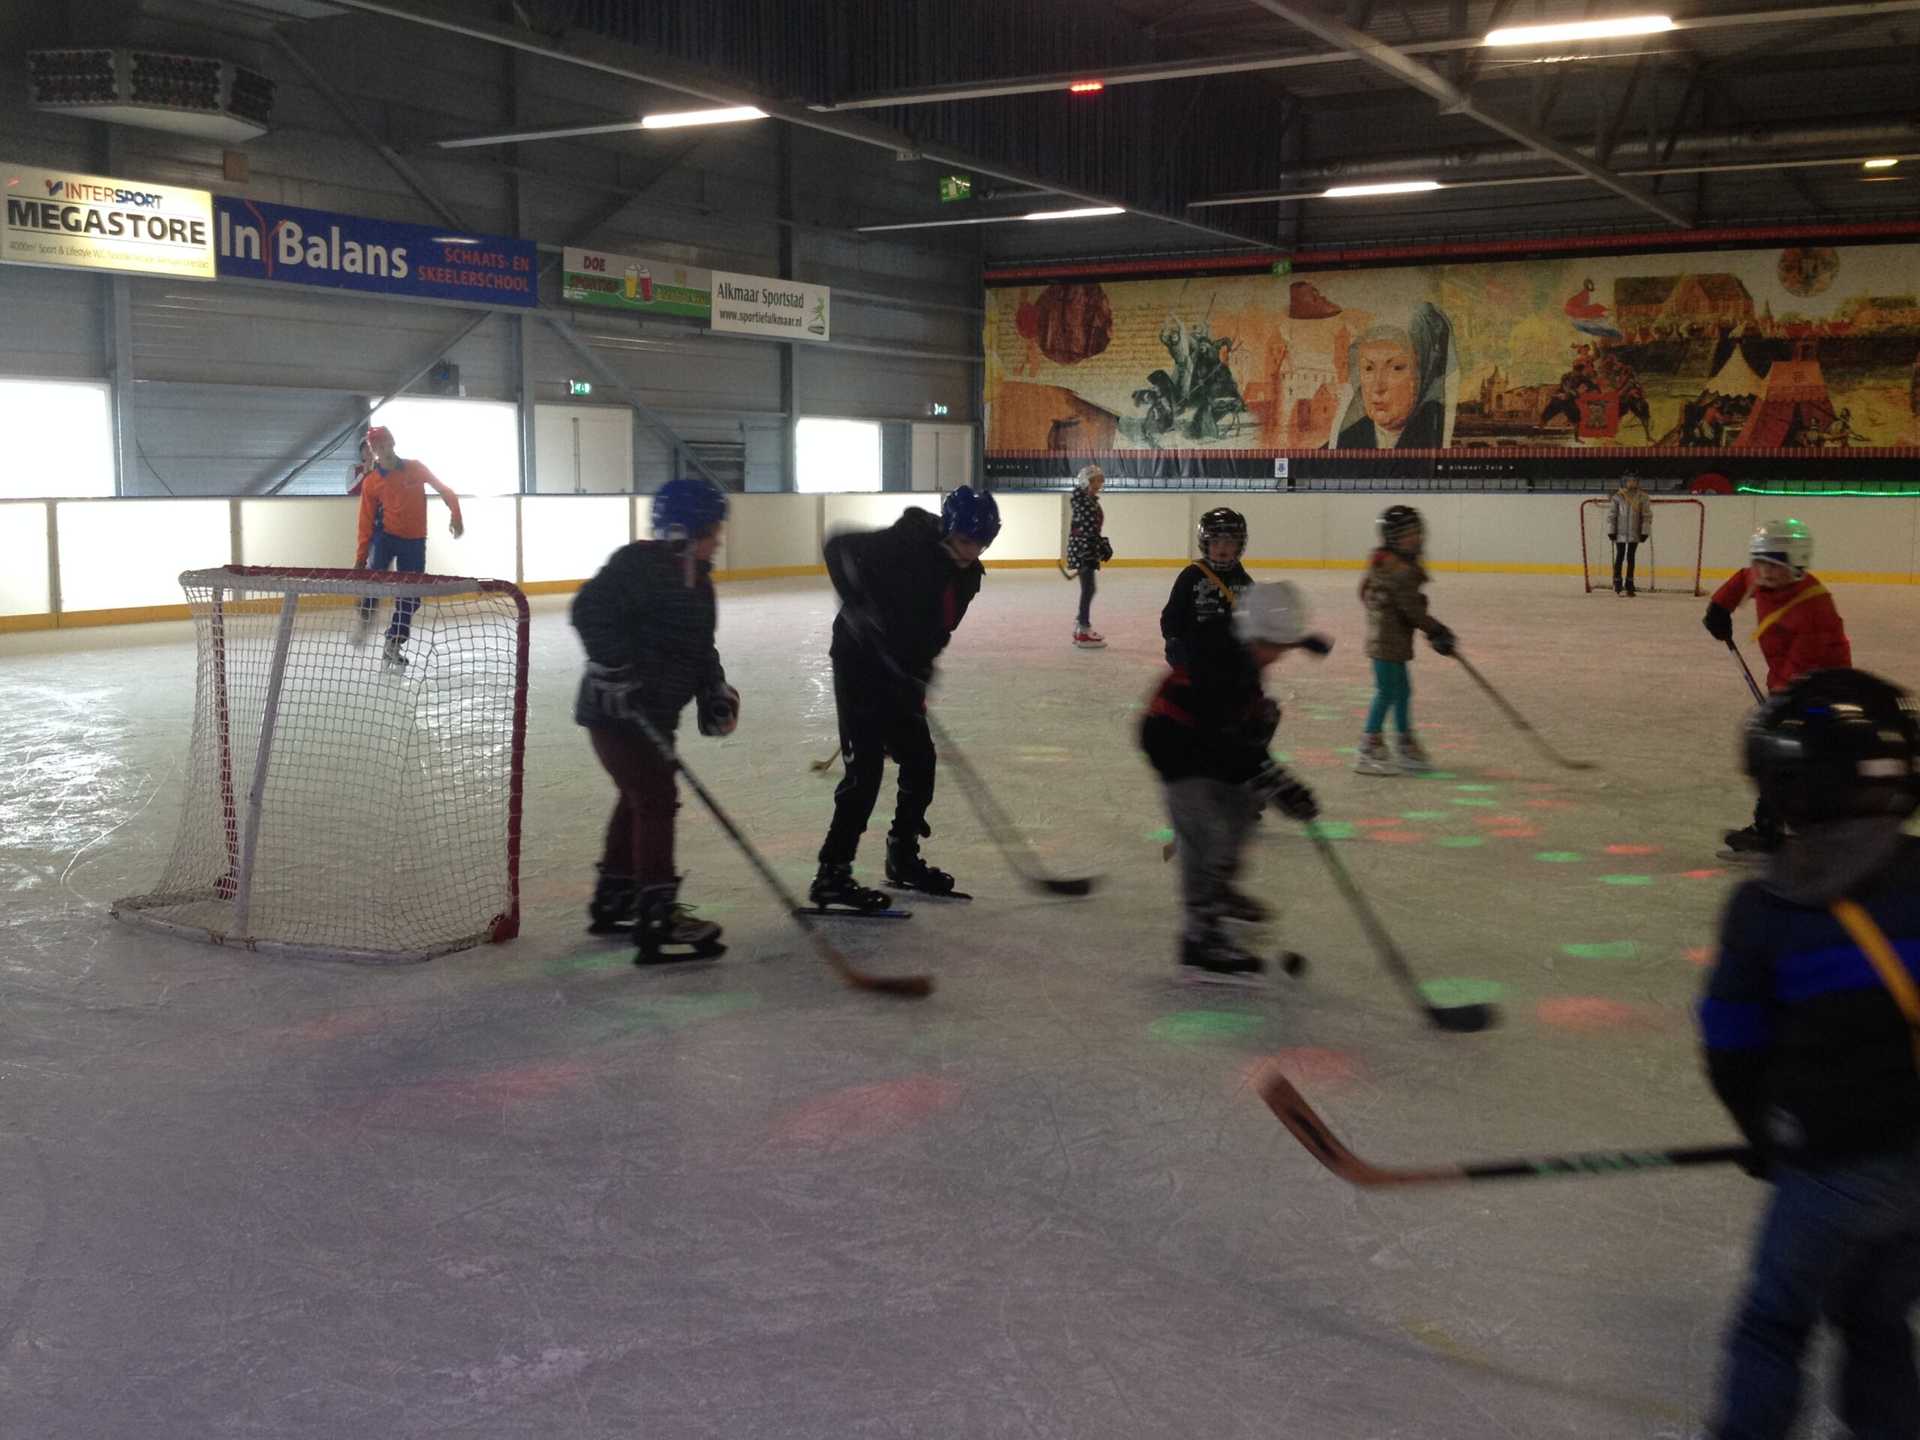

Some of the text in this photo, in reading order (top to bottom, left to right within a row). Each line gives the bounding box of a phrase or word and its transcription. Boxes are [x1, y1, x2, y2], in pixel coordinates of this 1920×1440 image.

[65, 182, 163, 209] INTERSPORT
[8, 199, 207, 245] MEGASTORE
[220, 211, 260, 260] In
[278, 220, 409, 279] Balans
[512, 255, 530, 272] EN
[416, 265, 530, 293] SKEELERSCHOOL
[718, 282, 759, 302] Alkmaar
[761, 288, 805, 309] Sportstad
